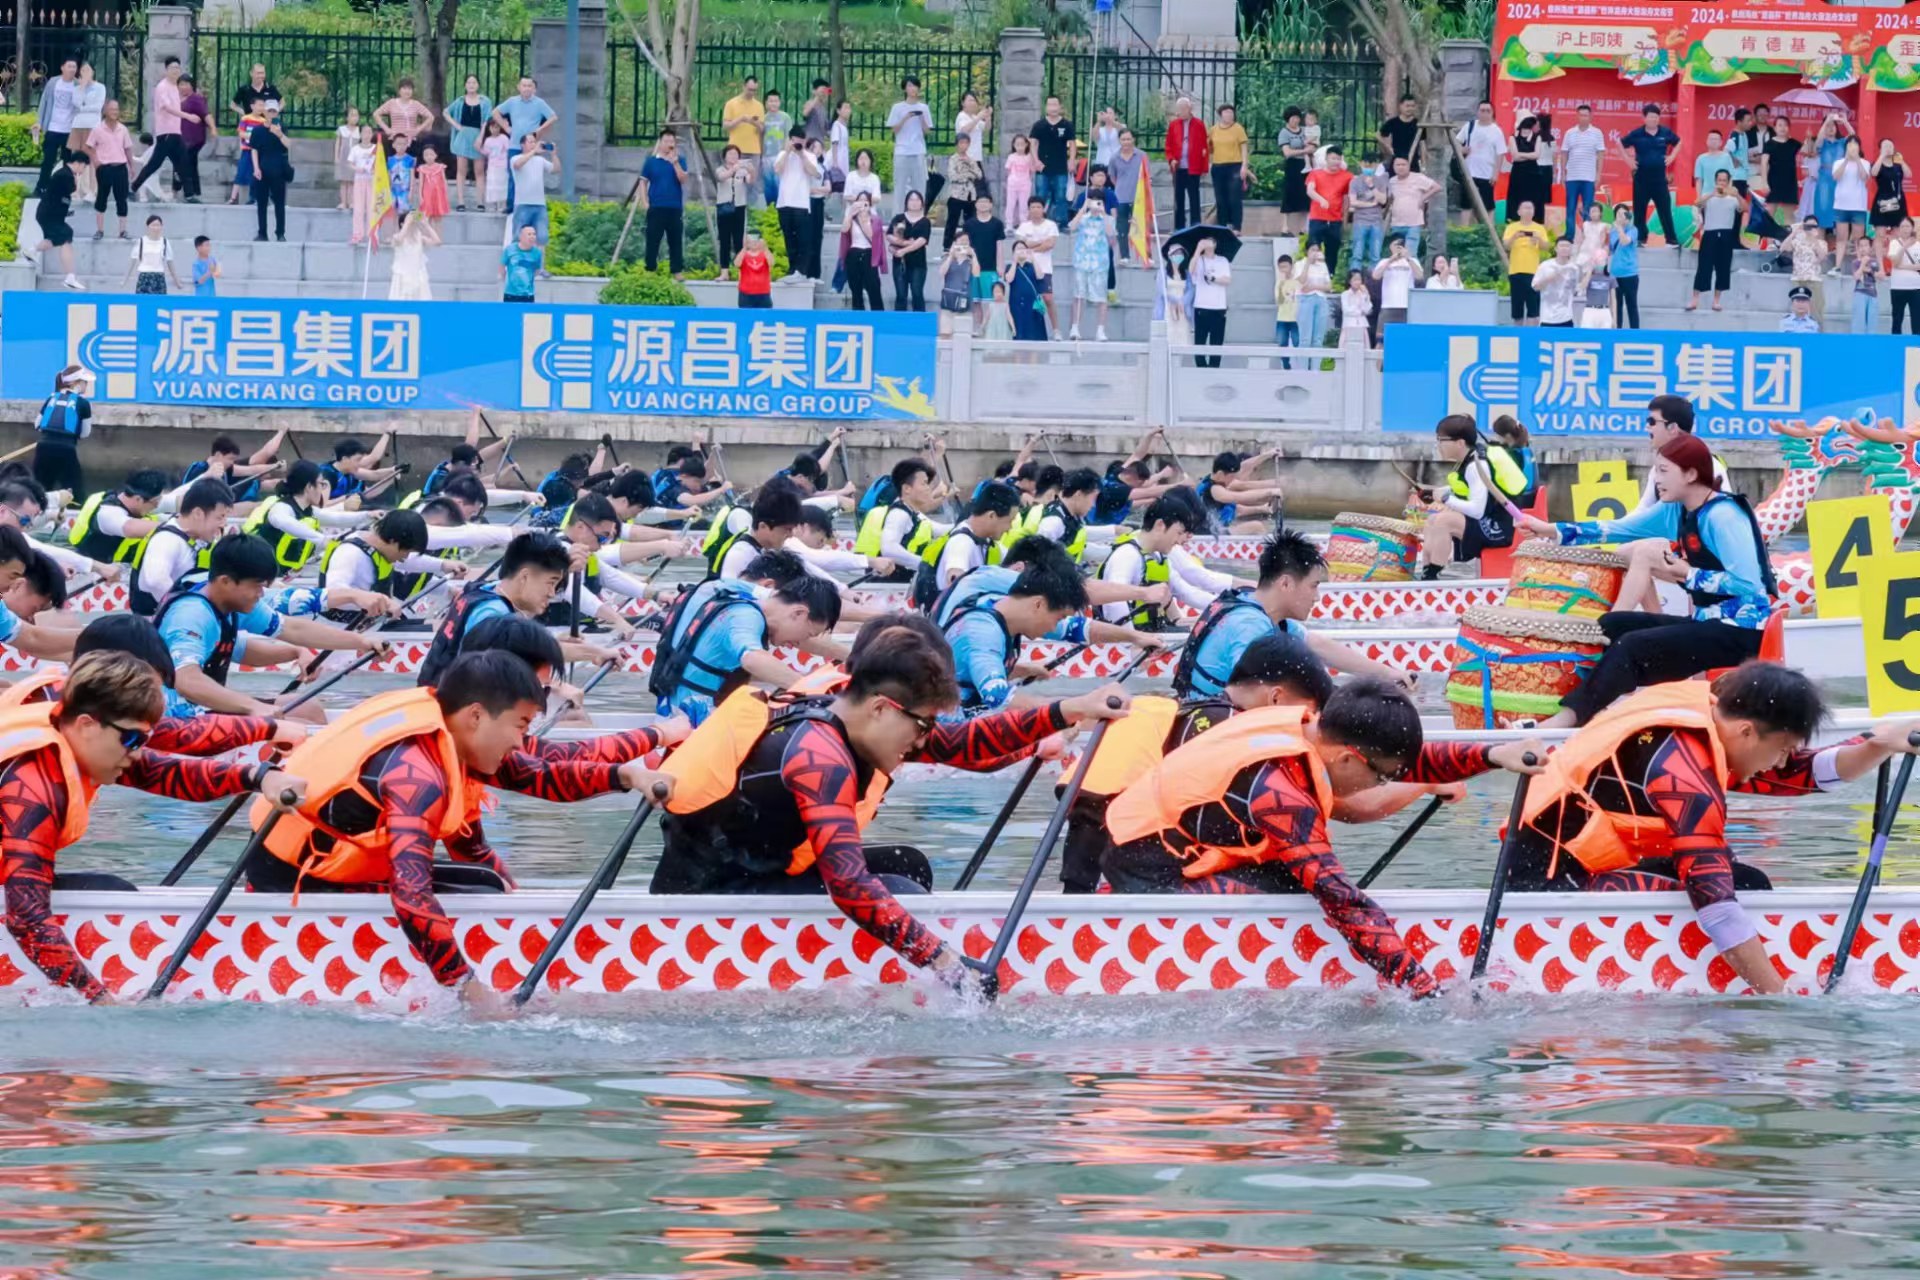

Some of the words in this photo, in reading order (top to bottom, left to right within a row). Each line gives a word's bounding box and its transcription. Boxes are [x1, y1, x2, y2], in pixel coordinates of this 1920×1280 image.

[1557, 31, 1623, 48] 沪上阿姨
[1900, 40, 1920, 57] 歪
[152, 308, 420, 380] 源昌集团
[607, 319, 874, 391] 源昌集团
[1533, 341, 1802, 413] 源昌集团
[153, 381, 316, 401] YUANCHANG
[327, 384, 419, 403] GROUP
[608, 391, 770, 412] YUANCHANG
[781, 395, 872, 414] GROUP
[1535, 413, 1697, 433] YUANCH
[1824, 516, 1873, 589] 4
